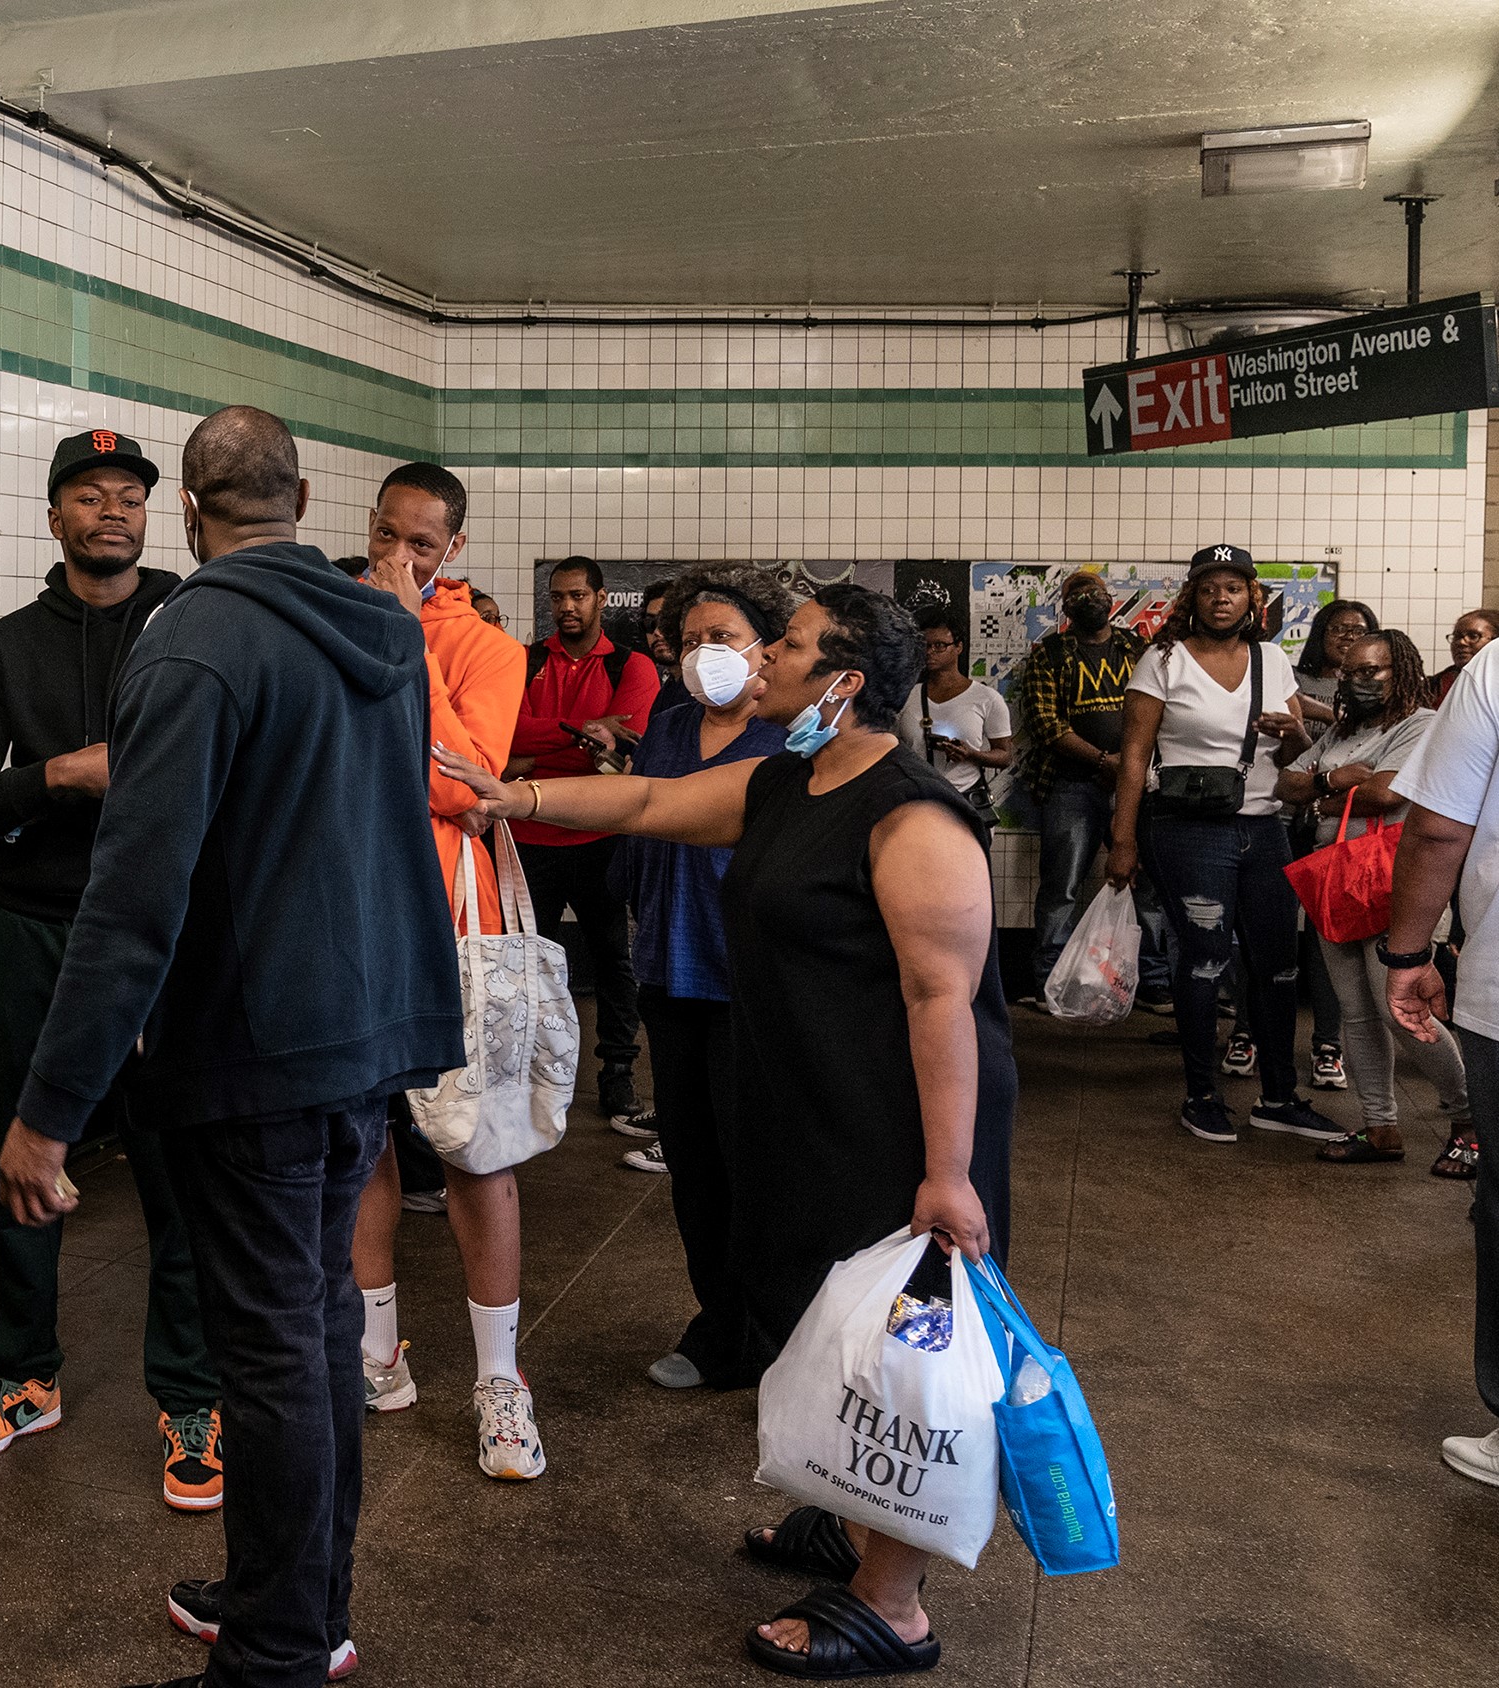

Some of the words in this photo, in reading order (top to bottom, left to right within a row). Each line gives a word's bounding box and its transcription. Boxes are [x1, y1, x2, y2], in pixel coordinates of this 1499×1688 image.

[1227, 339, 1340, 379] Washington
[1350, 325, 1431, 358] Avenue
[1442, 313, 1460, 344] &
[1128, 358, 1226, 436] Exit
[1228, 379, 1286, 409] Fulton
[1294, 365, 1359, 399] Street
[1214, 546, 1233, 562] NY
[836, 1383, 963, 1465] THANK
[805, 1460, 828, 1480] FOR
[830, 1475, 890, 1509] SHOPPING
[894, 1502, 926, 1521] WITH
[929, 1514, 949, 1526] US!
[845, 1436, 928, 1497] YOU
[1048, 1463, 1084, 1543] liquiteria.com
